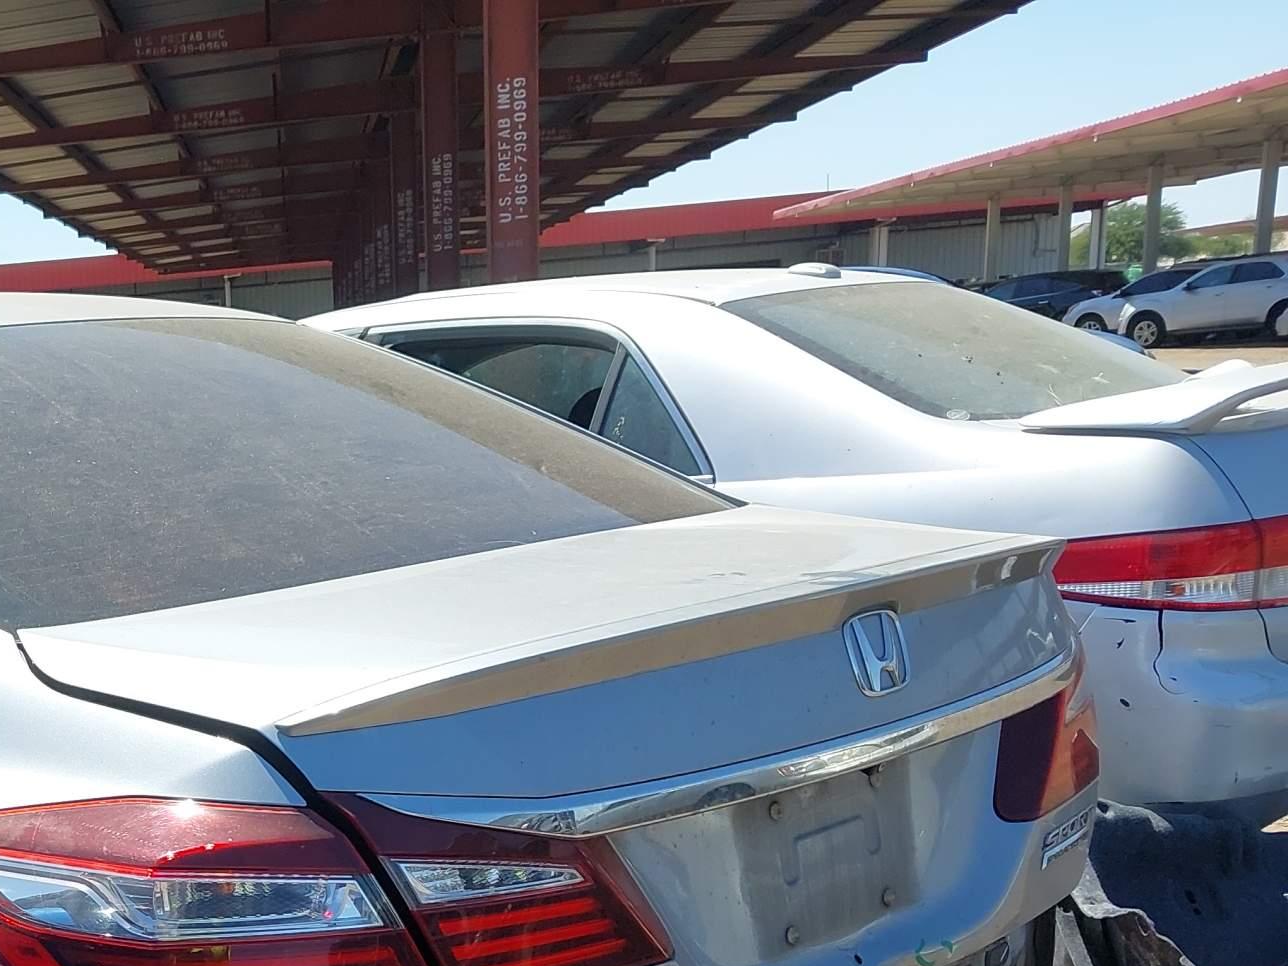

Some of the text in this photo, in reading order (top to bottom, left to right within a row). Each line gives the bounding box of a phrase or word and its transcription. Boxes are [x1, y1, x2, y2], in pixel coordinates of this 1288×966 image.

[432, 180, 443, 225] PREFAB
[497, 77, 513, 223] U.S. PREFAB INC.
[513, 76, 529, 219] 1-866-799-0969
